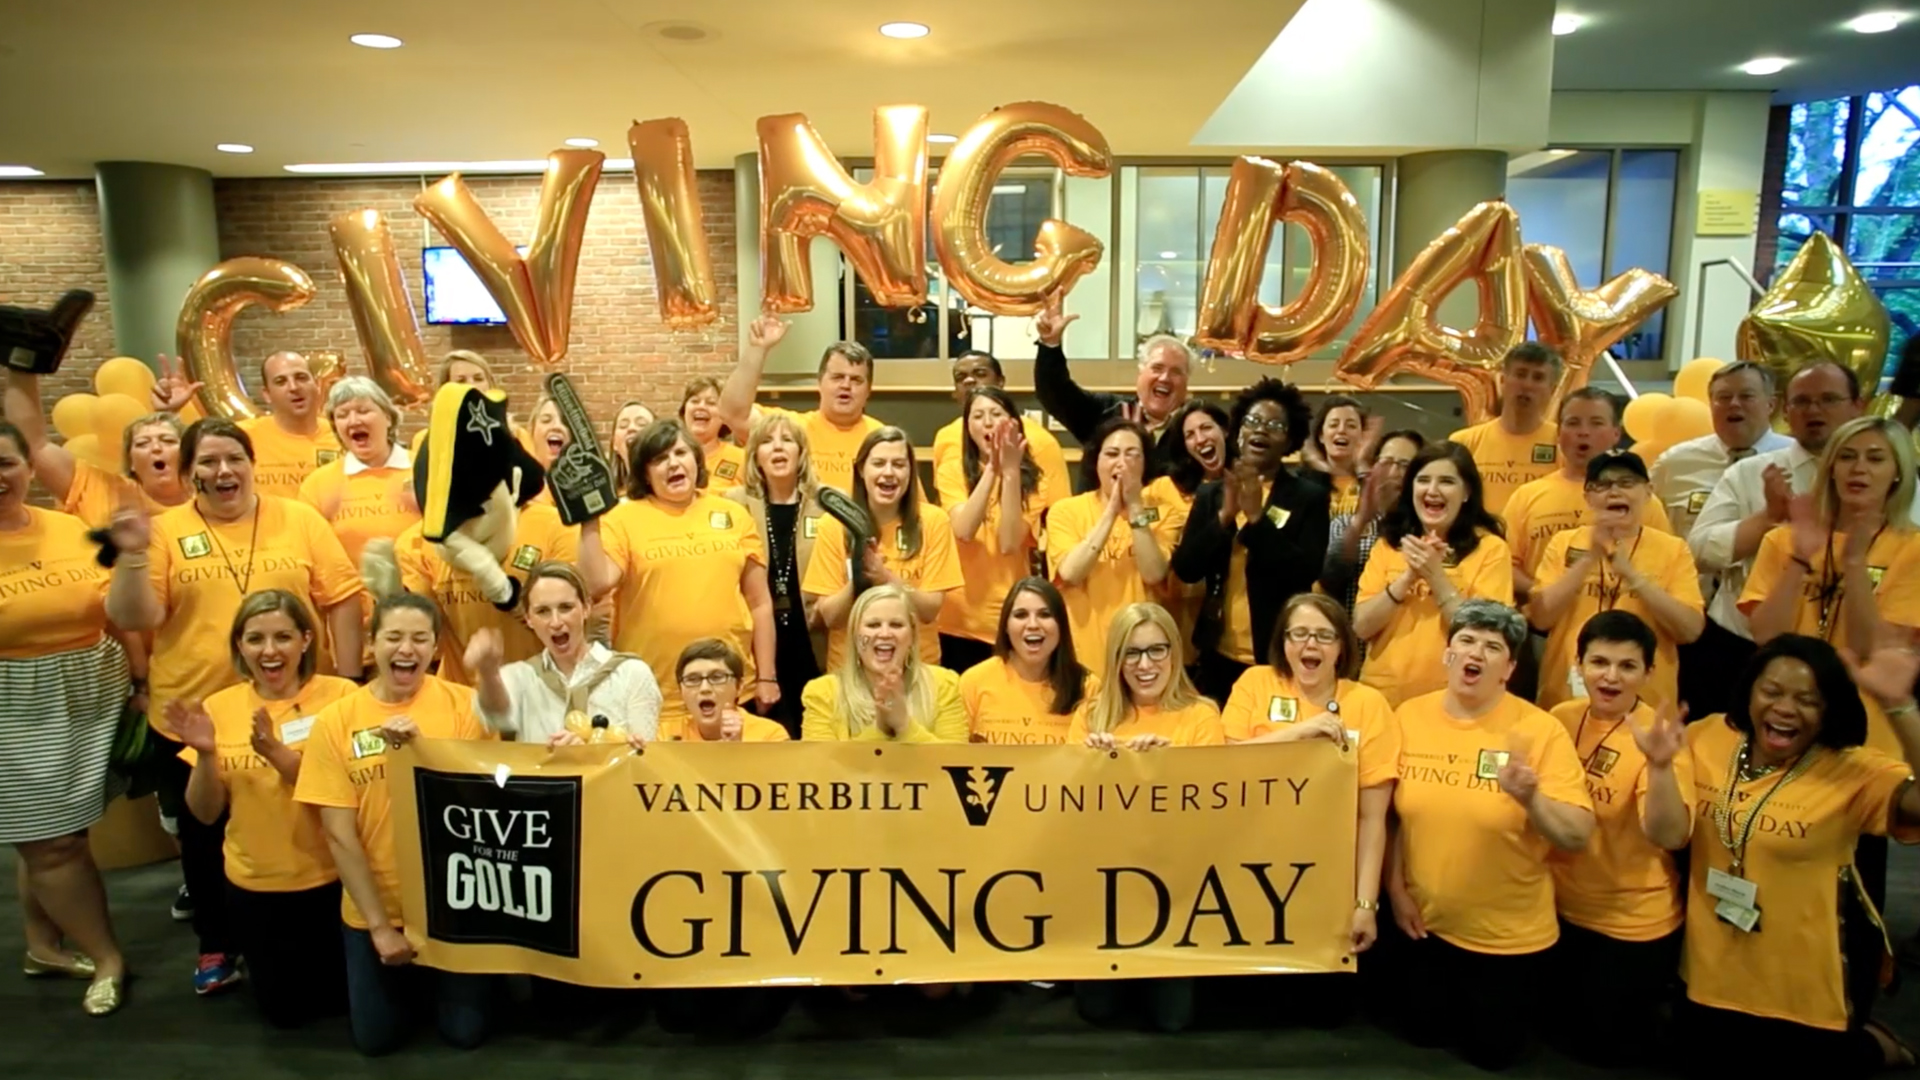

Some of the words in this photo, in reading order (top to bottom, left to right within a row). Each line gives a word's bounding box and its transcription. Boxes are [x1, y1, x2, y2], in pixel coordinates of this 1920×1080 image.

[176, 101, 1112, 420] GIVING
[1197, 154, 1680, 422] DAY
[816, 460, 851, 473] VING
[644, 542, 706, 561] GIVING
[711, 539, 741, 553] DAY
[178, 562, 255, 584] GIVING
[262, 556, 299, 573] DAY
[901, 567, 924, 580] DA
[0, 571, 63, 599] IVING
[66, 566, 101, 582] DAY
[984, 731, 1037, 745] IVING
[220, 755, 268, 771] IVIN
[348, 764, 385, 785] GIVI
[635, 782, 929, 812] VANDERBILT
[1025, 778, 1309, 812] UNIVERSITY
[443, 804, 552, 848] GIVE
[1758, 814, 1814, 838] DAY
[473, 845, 493, 858] FOR
[496, 849, 519, 861] THE
[447, 852, 552, 922] GOLD
[631, 867, 1052, 959] GIVING
[1096, 862, 1316, 950] DAY
